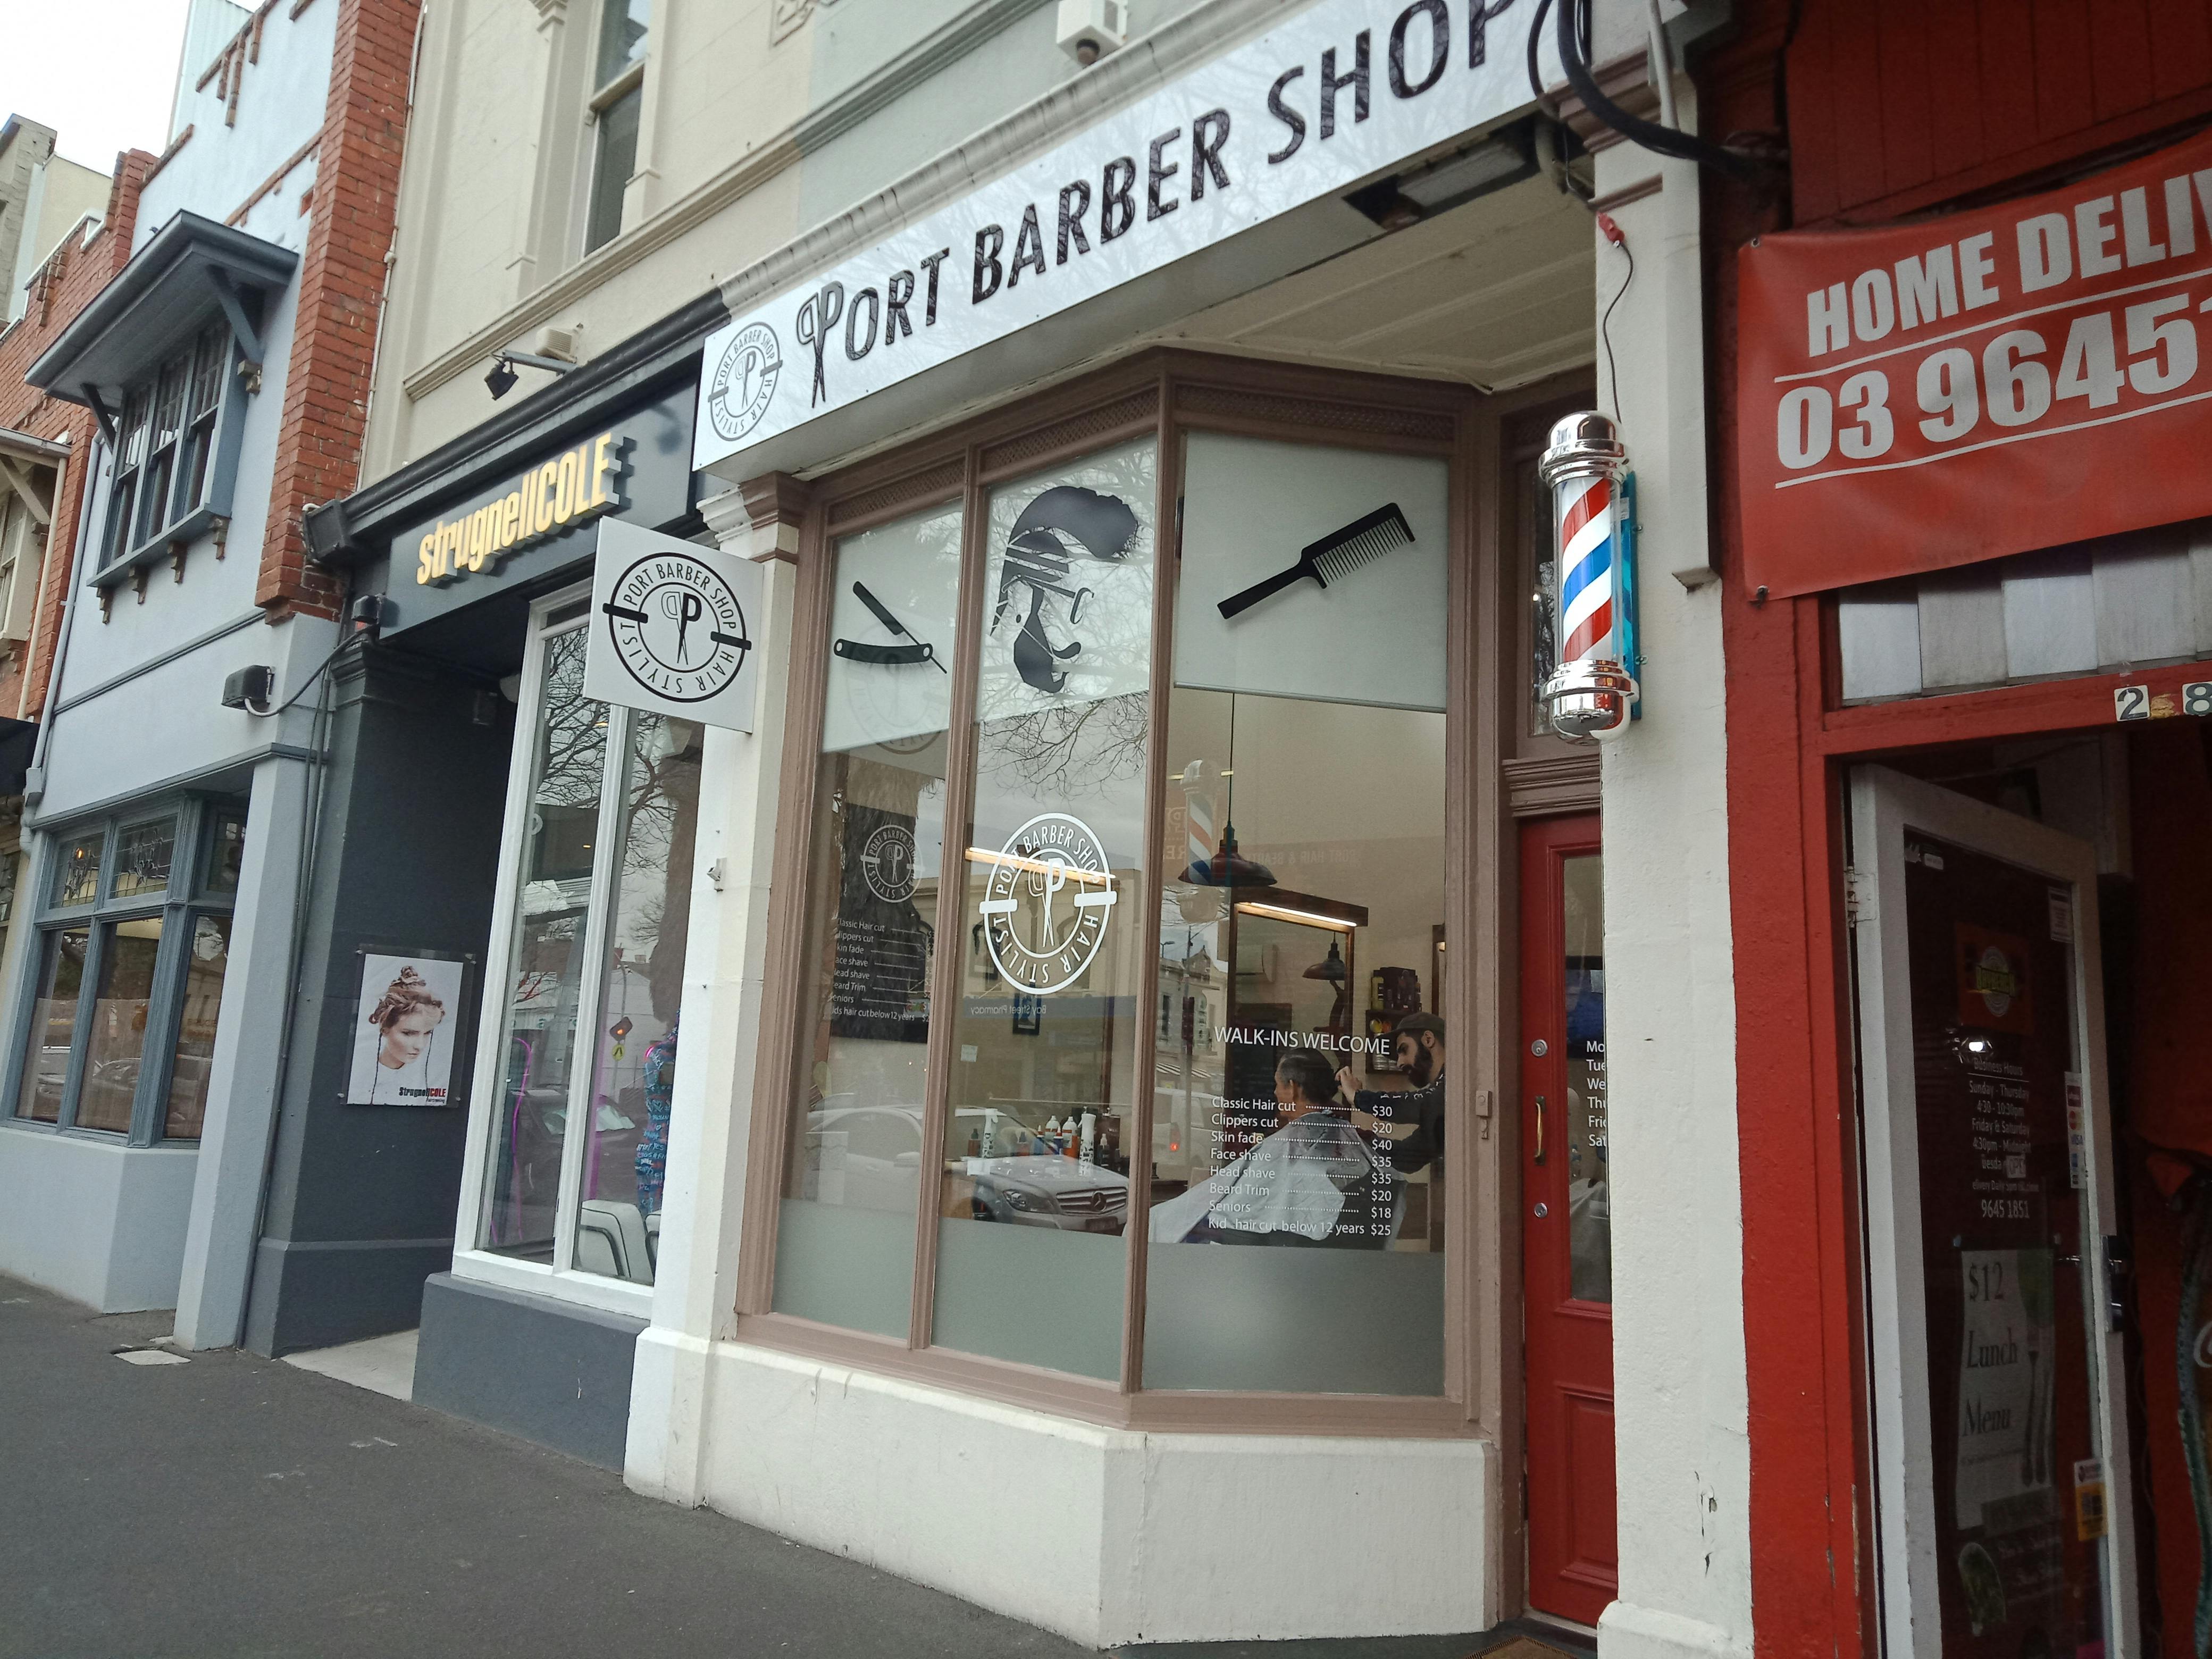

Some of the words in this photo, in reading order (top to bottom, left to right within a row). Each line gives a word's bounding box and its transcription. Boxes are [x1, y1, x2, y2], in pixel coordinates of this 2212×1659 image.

[796, 247, 950, 408] PORT
[972, 108, 1232, 305] BARBER
[1807, 231, 1999, 357] HOME
[718, 355, 733, 386] PORT
[733, 330, 761, 354] BARBER
[761, 333, 774, 359] SHOP
[1778, 370, 1895, 470] 03
[1916, 293, 2212, 442] 9645
[751, 379, 773, 420] HAIR
[715, 400, 744, 434] STYLIST
[416, 432, 620, 585] strugnellCOLE
[623, 568, 653, 606] PORT
[656, 563, 710, 590] BARBER
[710, 588, 736, 629] SHOP
[621, 623, 682, 693] STYLIST
[695, 651, 734, 691] HAIR
[869, 835, 882, 856] PORT
[883, 830, 907, 843] BARBER
[1023, 825, 1075, 853] BARBER
[868, 864, 895, 898] STYLIST
[838, 931, 861, 942] lippers
[839, 919, 858, 928] lassic
[859, 921, 873, 930] Hair
[837, 943, 847, 952] kin
[849, 944, 864, 954] fade
[993, 917, 1049, 983] STYLIST
[1060, 915, 1099, 973] HAIR
[849, 958, 868, 967] shave
[834, 982, 850, 990] eard
[851, 982, 866, 992] Trim
[851, 970, 870, 980] shave
[833, 994, 854, 1003] eniors
[844, 1007, 857, 1016] hair
[1214, 1026, 1298, 1048] WALK-INS
[1303, 1032, 1390, 1055] WELCOME
[1969, 1080, 1994, 1099] Sunday
[1999, 1084, 2029, 1103] Thursday
[1212, 1096, 1250, 1109] Classic
[1252, 1099, 1276, 1110] Hair
[1278, 1101, 1296, 1112] cut
[1372, 1104, 1393, 1117] $30
[1211, 1113, 1258, 1128] Clippers
[1261, 1117, 1279, 1128] cut
[1372, 1122, 1393, 1134] $20
[1972, 1118, 1992, 1135] Friday
[2002, 1120, 2030, 1138] Saturday
[1211, 1131, 1235, 1143] Skin
[1237, 1132, 1263, 1144] fade
[1372, 1139, 1392, 1151] $40
[1210, 1148, 1238, 1160] Face
[1241, 1150, 1271, 1161] shave
[1371, 1156, 1392, 1168] $35
[1210, 1166, 1240, 1177] Head
[1243, 1167, 1275, 1179] shave
[1371, 1173, 1392, 1185] $35
[1210, 1183, 1242, 1194] Beard
[1245, 1184, 1269, 1196] Trim
[1371, 1190, 1392, 1202] $20
[1209, 1201, 1251, 1212] Seniors
[1371, 1207, 1392, 1219] $18
[1982, 1199, 2005, 1218] 9645
[2007, 1200, 2030, 1219] 1851
[1208, 1218, 1228, 1229] Kid
[1236, 1218, 1256, 1230] hair
[1259, 1220, 1277, 1231] cut
[1281, 1220, 1317, 1232] below
[1321, 1222, 1333, 1233] 12
[1335, 1224, 1364, 1236] years
[1371, 1224, 1391, 1236] $25
[1969, 1261, 2004, 1302] $12
[1966, 1327, 2018, 1369] Lunch
[1963, 1398, 2012, 1437] Menu
